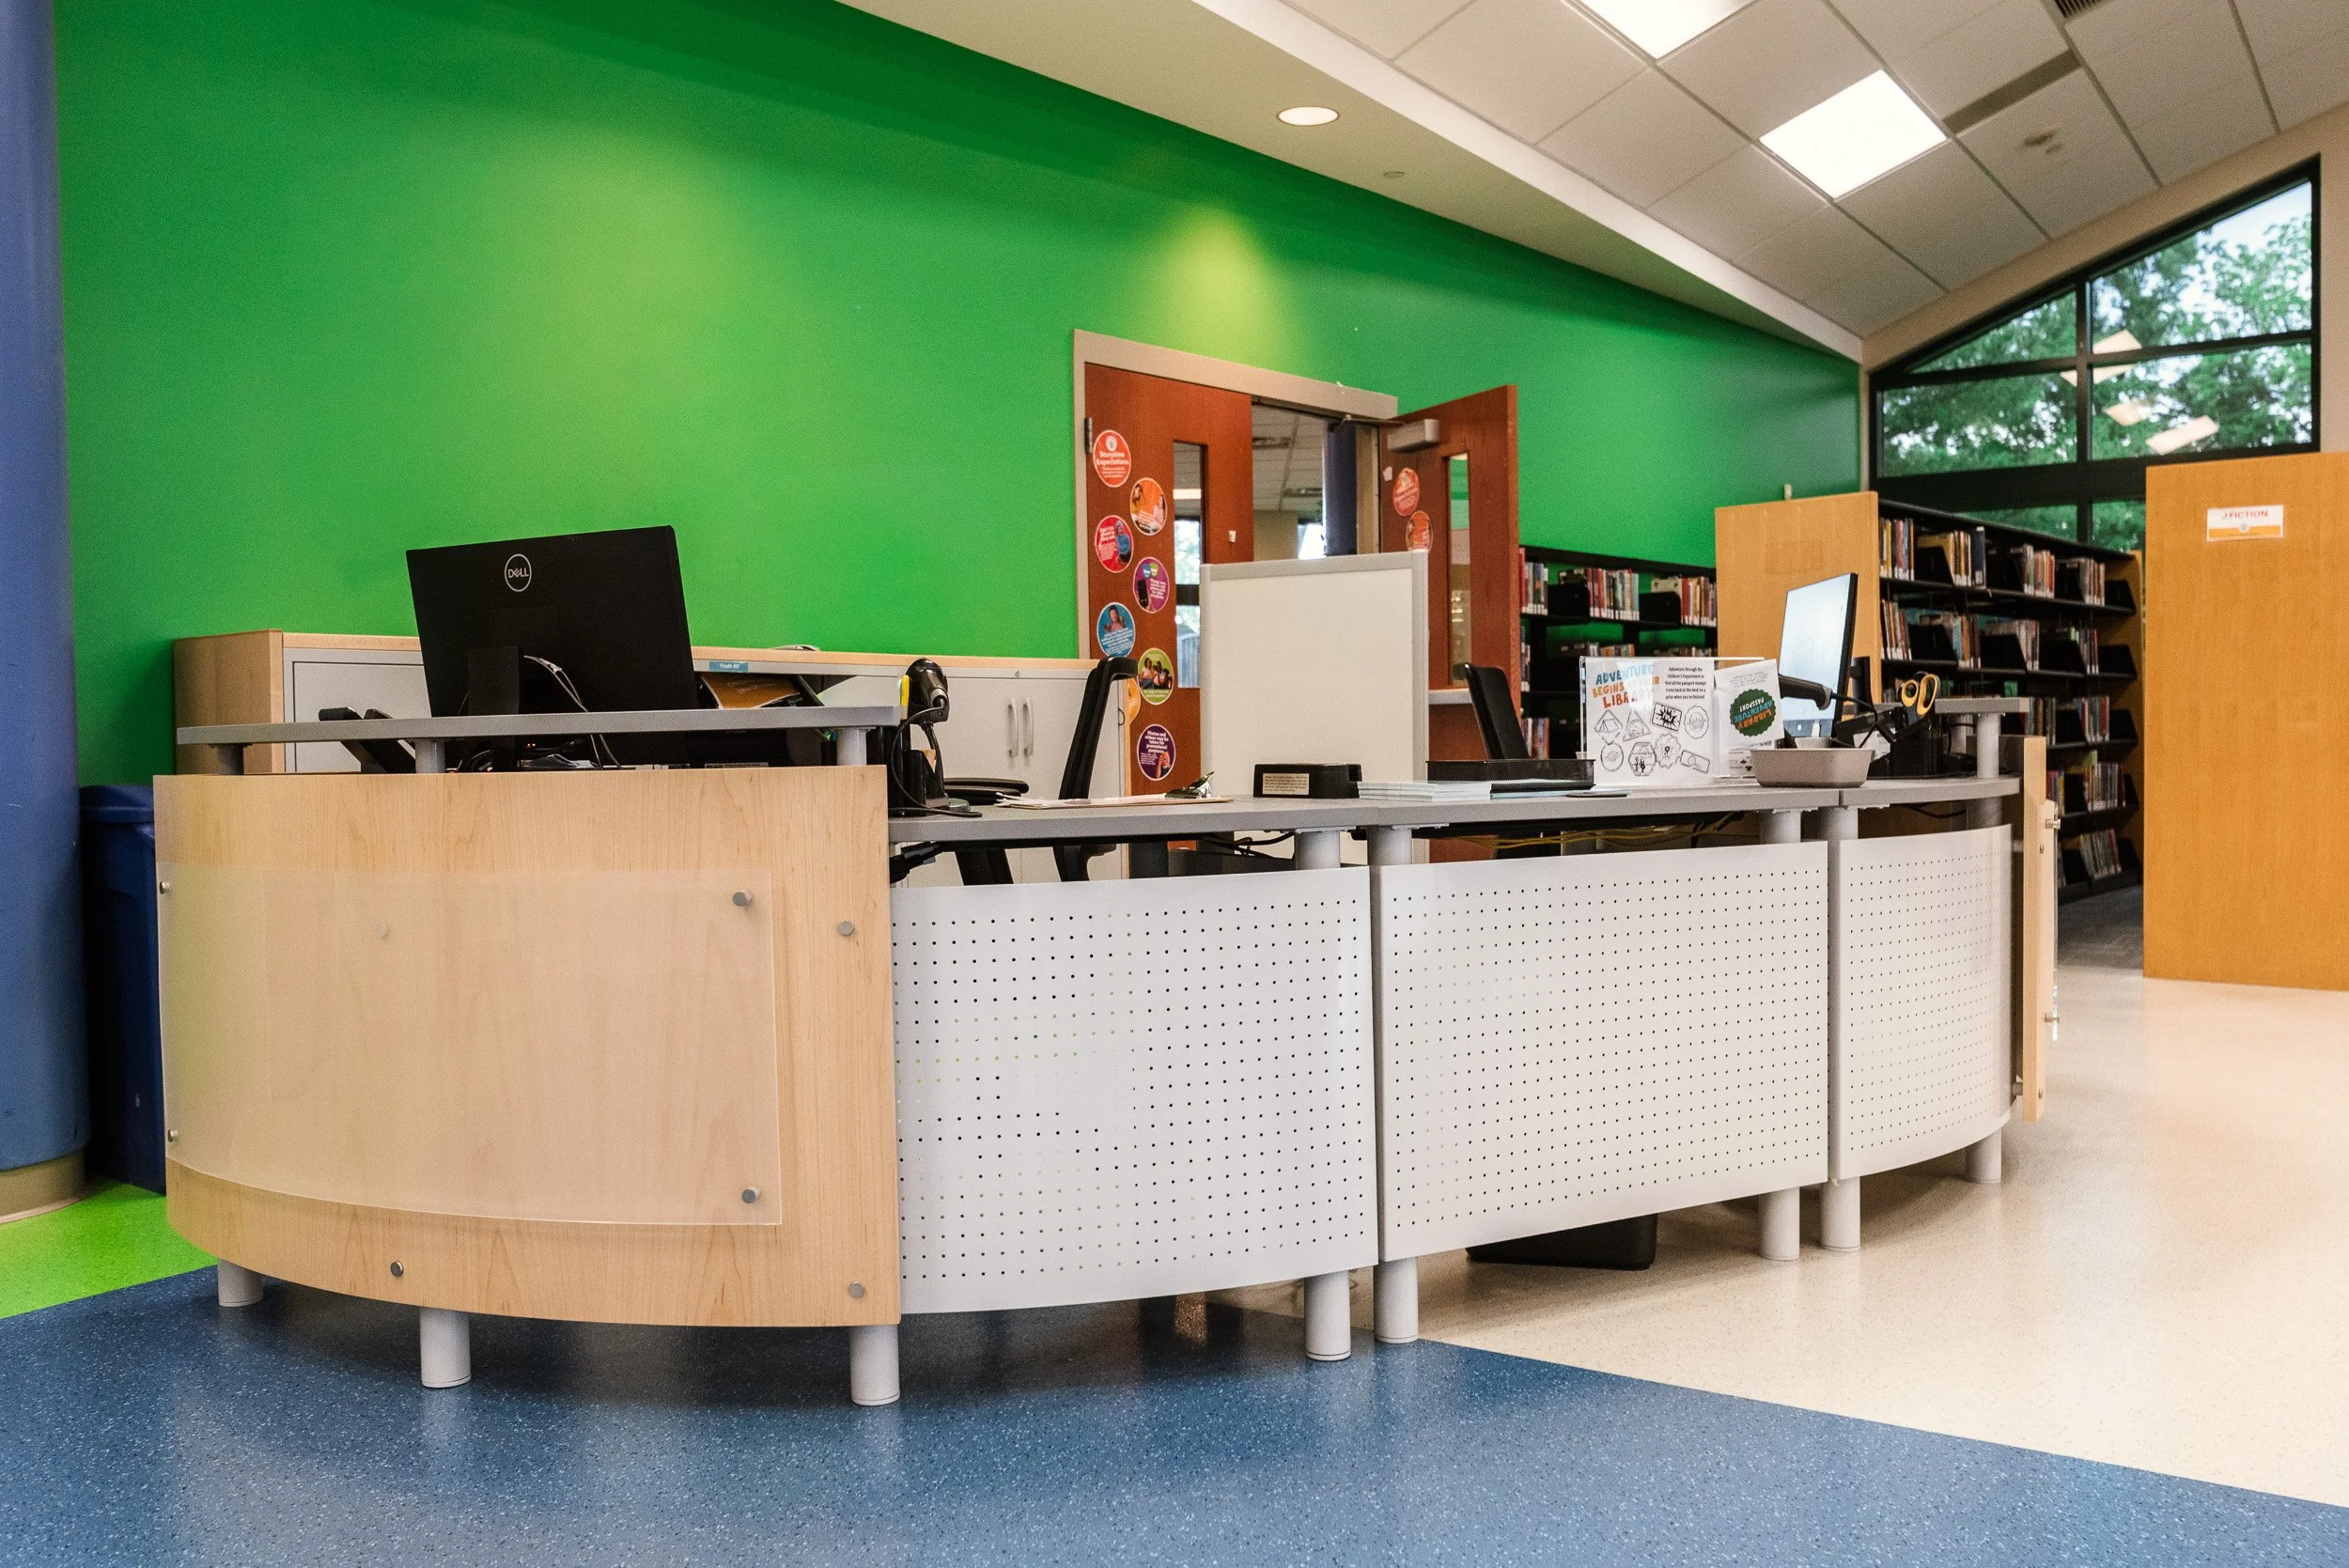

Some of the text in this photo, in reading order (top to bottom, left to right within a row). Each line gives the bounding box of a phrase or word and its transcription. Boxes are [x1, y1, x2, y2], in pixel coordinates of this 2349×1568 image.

[508, 567, 529, 579] DELL
[1595, 663, 1654, 686] ADVENTURE
[1593, 681, 1625, 698] BEGINS
[1734, 700, 1773, 723] ADVENTURE
[1739, 697, 1765, 712] PASSPORT
[1737, 709, 1772, 730] LIBRARY
